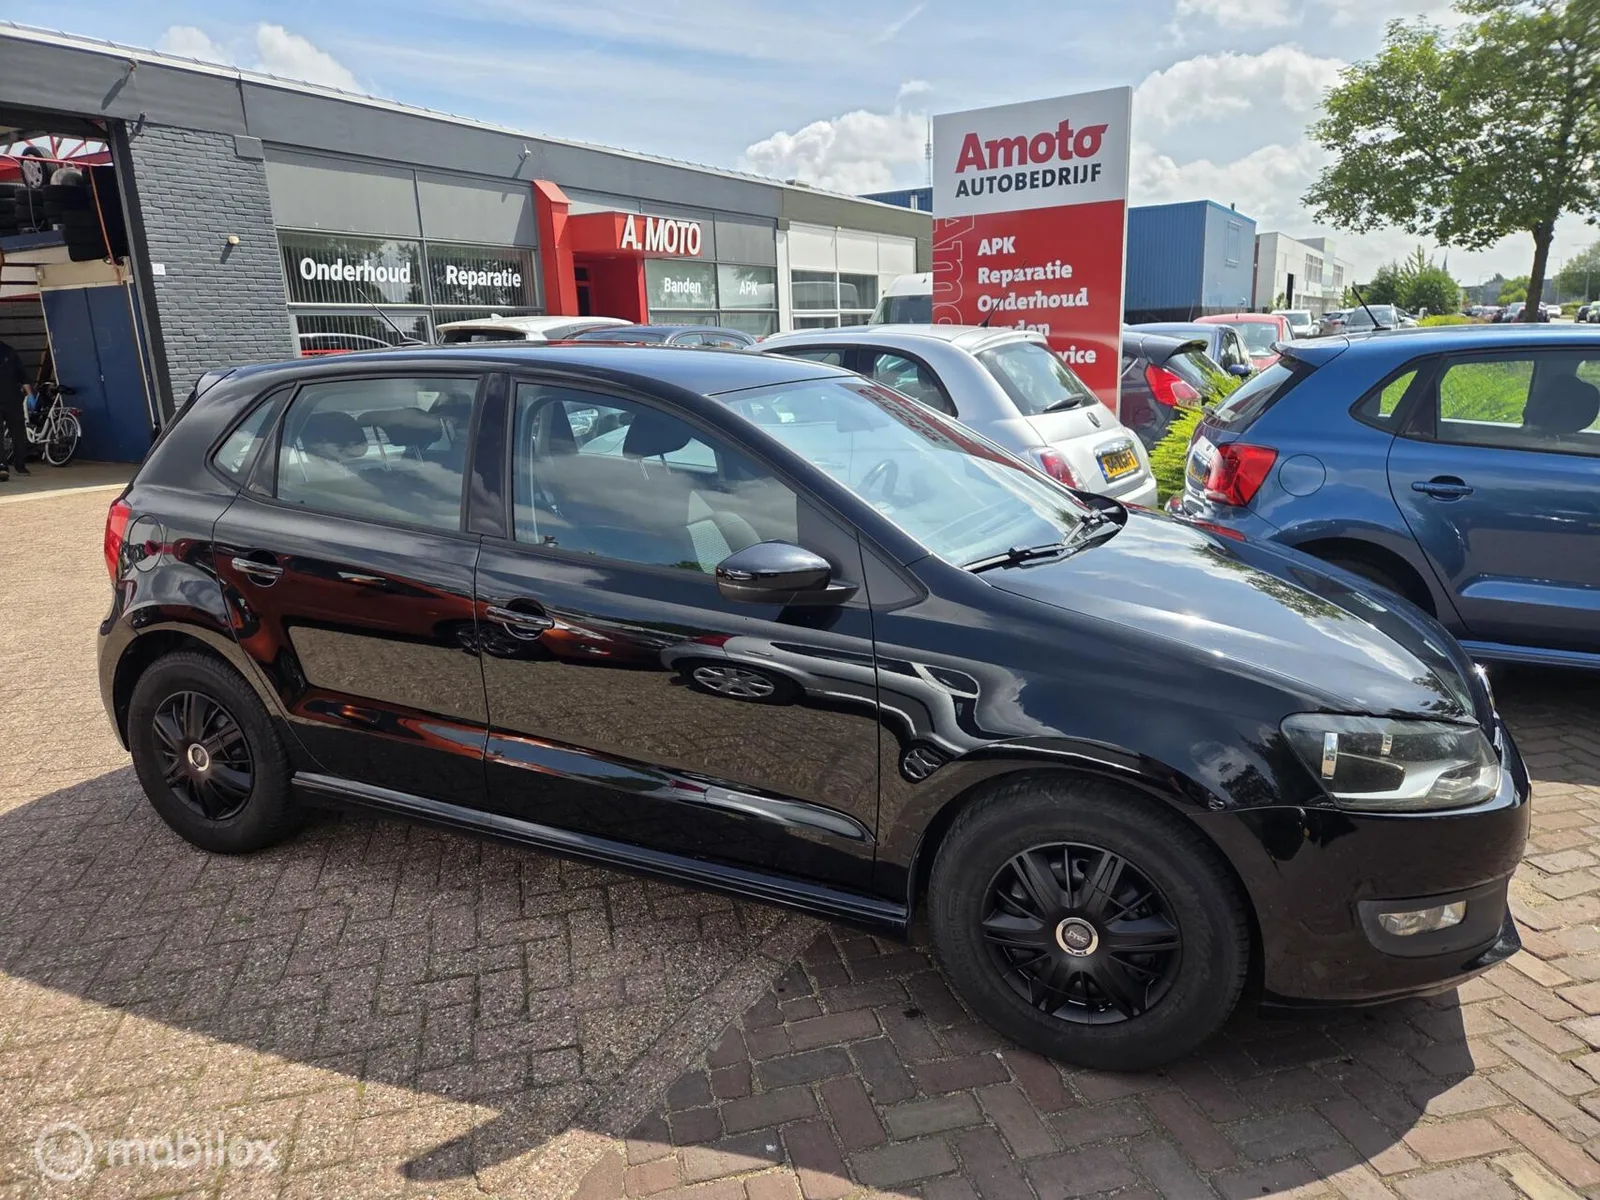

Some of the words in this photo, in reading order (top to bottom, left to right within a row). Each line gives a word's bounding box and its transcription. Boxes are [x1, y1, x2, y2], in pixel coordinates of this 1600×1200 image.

[955, 119, 1109, 173] Amoto
[955, 163, 1101, 198] AUTOBEDRIJF
[621, 214, 642, 250] A.
[645, 217, 701, 255] MOTO
[977, 236, 1016, 256] APK
[300, 257, 411, 284] Onderhoud
[446, 265, 521, 290] Reparatie
[977, 260, 1073, 288] Reparatie
[664, 277, 701, 294] Banden
[739, 281, 758, 296] APK
[977, 288, 1088, 313] Onderhoud
